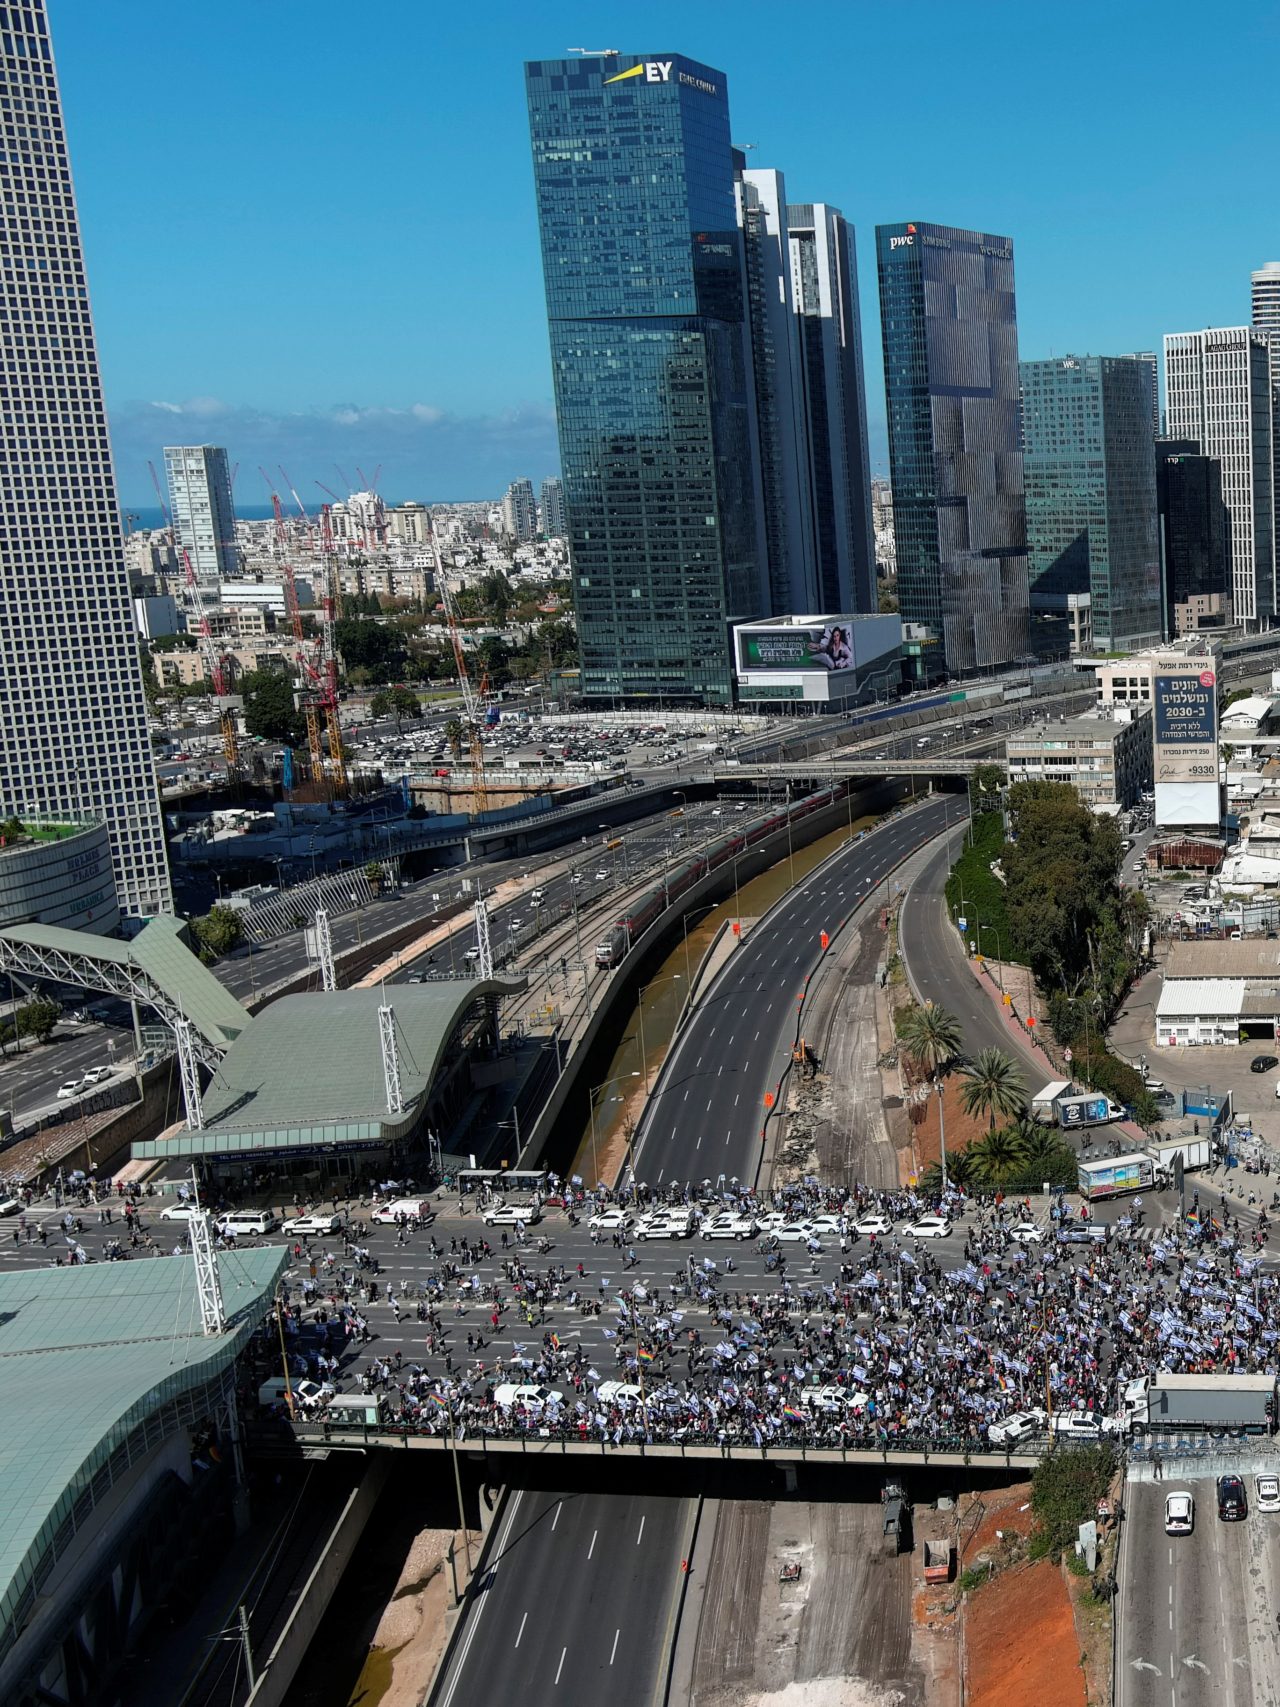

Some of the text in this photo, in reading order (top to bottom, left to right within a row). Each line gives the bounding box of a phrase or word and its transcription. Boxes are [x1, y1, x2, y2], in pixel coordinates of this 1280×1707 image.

[645, 61, 672, 82] EY
[889, 235, 914, 250] pwc
[922, 235, 951, 248] SAMSUNG
[979, 244, 1010, 258] wework
[1158, 661, 1177, 670] אפעל
[1171, 680, 1198, 691] קונים
[1162, 691, 1209, 704] ומשלמים
[1166, 706, 1206, 717] ב-2030
[1188, 721, 1201, 729] ללא
